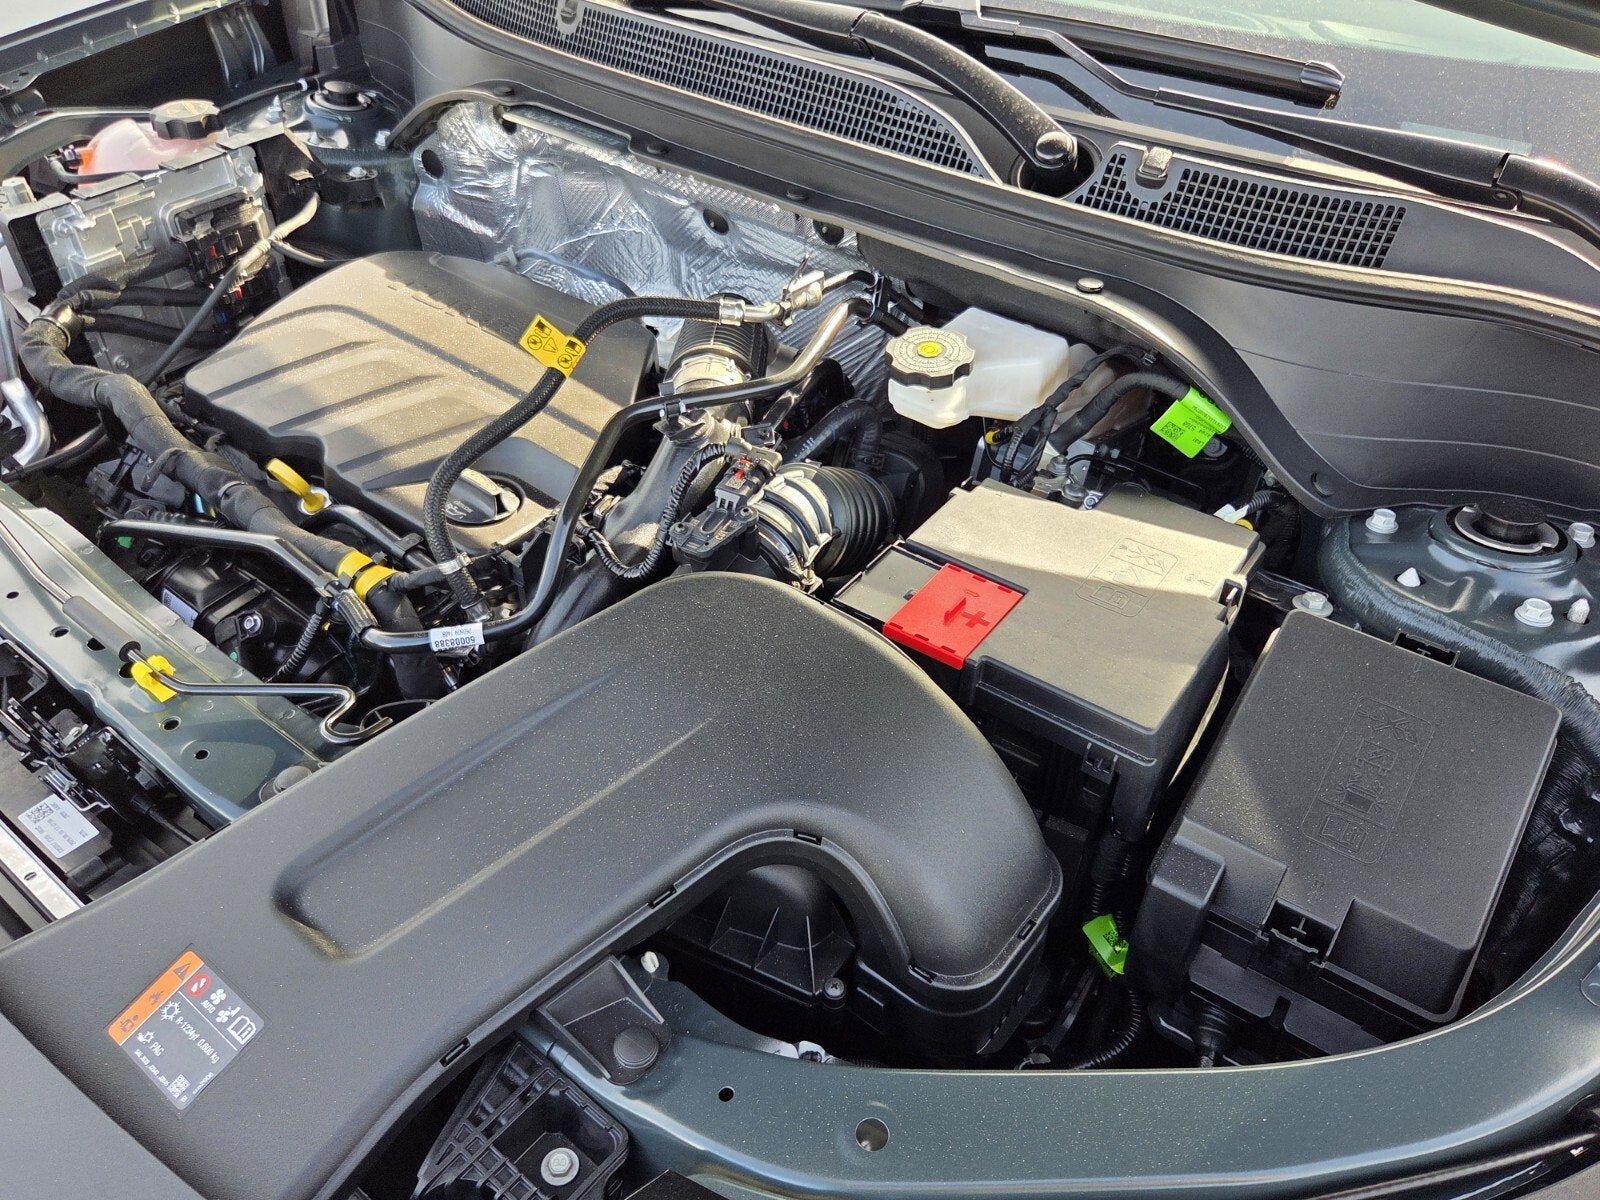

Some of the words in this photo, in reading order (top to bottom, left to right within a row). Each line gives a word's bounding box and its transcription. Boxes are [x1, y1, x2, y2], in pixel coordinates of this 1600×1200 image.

[202, 999, 216, 1014] AUTO
[149, 1041, 165, 1057] PAG
[210, 1052, 220, 1064] kg
